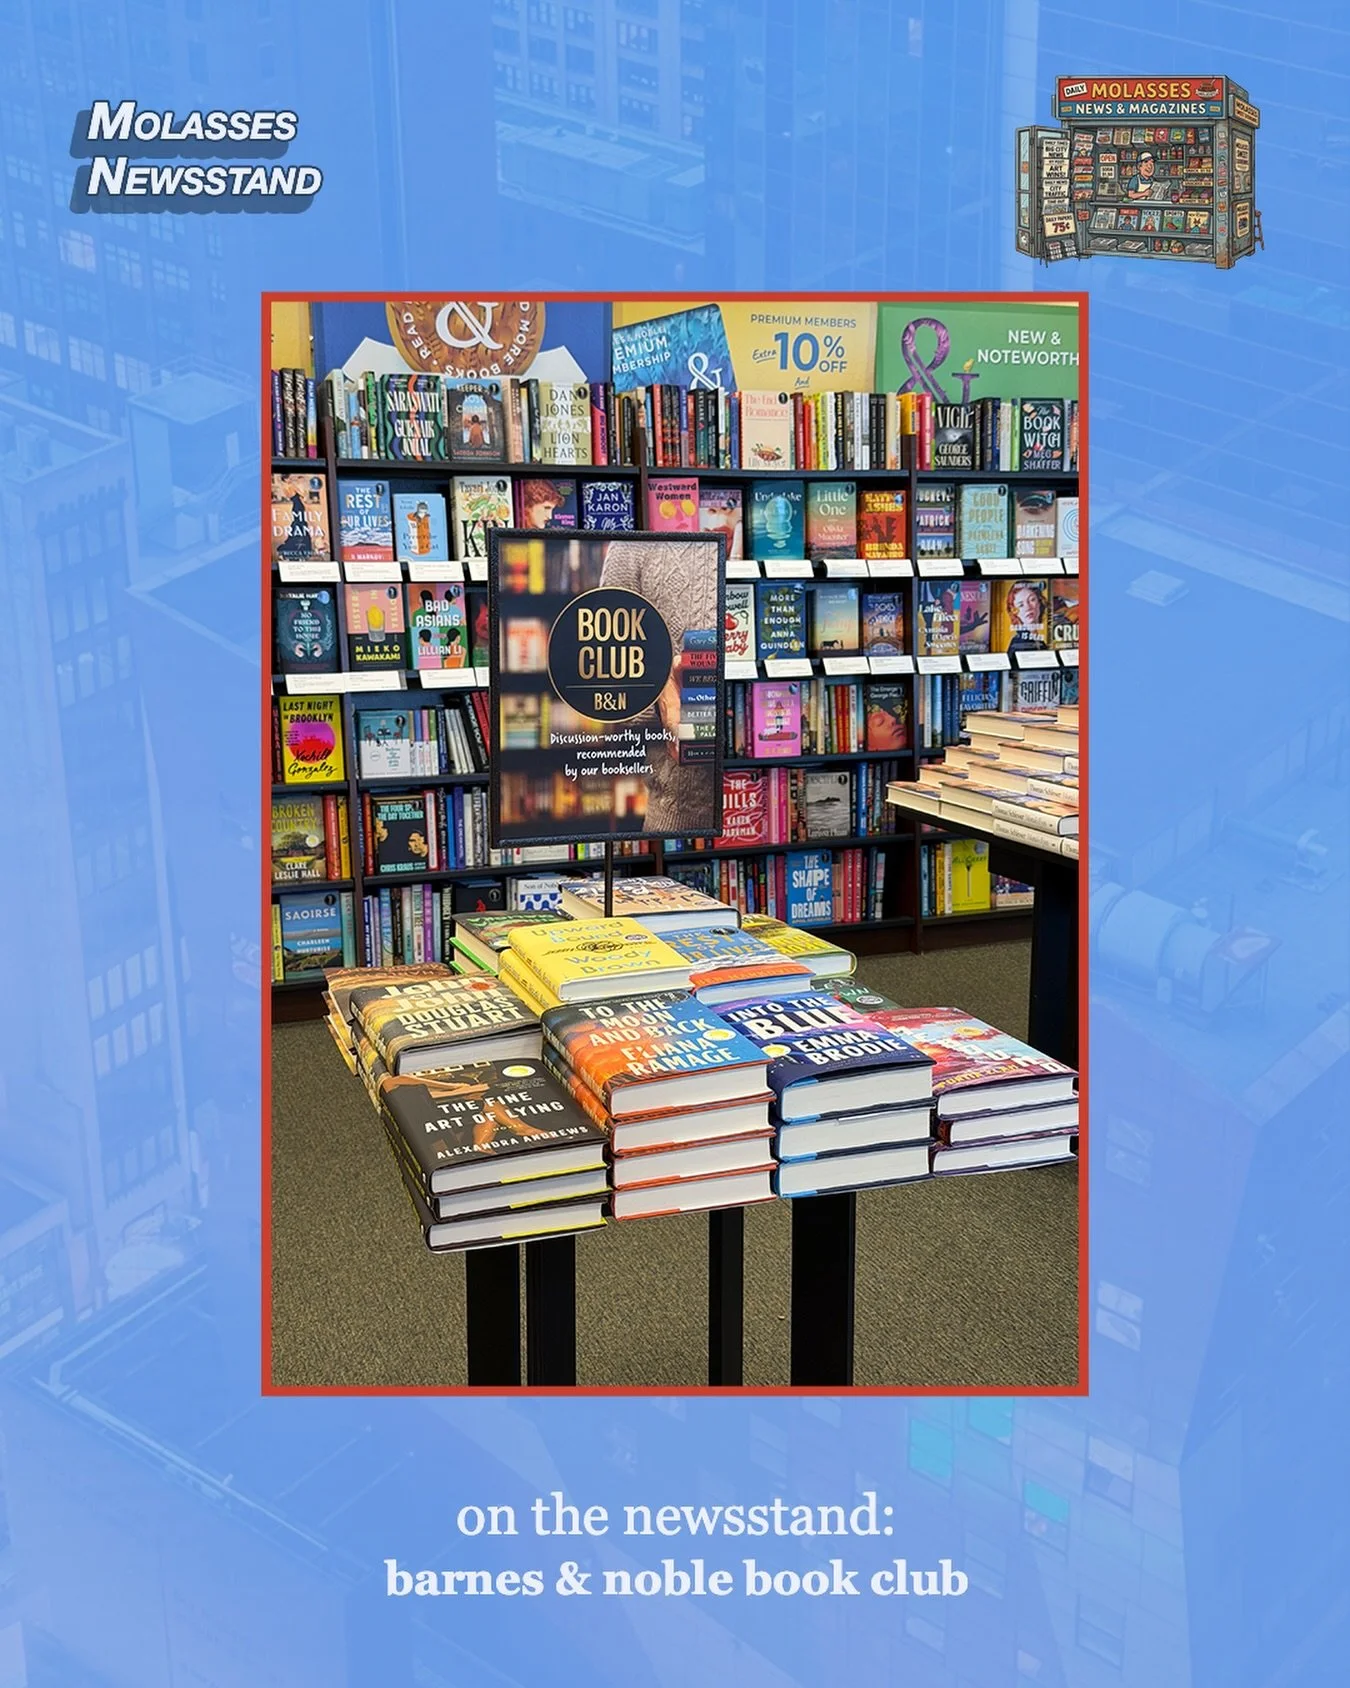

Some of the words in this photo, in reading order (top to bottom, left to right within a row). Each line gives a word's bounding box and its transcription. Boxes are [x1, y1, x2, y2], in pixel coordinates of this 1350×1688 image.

[751, 314, 801, 325] PREMIUM
[804, 317, 856, 328] MEMBERS
[403, 312, 431, 359] READ
[503, 319, 530, 365] MORE
[1008, 330, 1045, 344] NEW
[1050, 332, 1061, 345] &
[752, 349, 777, 360] Extra
[819, 360, 848, 373] OFF
[549, 390, 578, 401] DAN
[545, 403, 585, 416] JONES
[745, 407, 788, 417] Romance
[937, 405, 974, 428] VIGIL
[1023, 417, 1061, 430] BOOK
[550, 432, 579, 444] LION
[1023, 433, 1061, 447] WITCH
[543, 447, 588, 458] HEARTS
[938, 444, 968, 455] GEORGE
[1033, 450, 1052, 459] MEG
[935, 456, 972, 466] SAUNDERS
[1023, 461, 1061, 470] SHAFFER
[650, 481, 697, 492] Westward
[346, 494, 381, 509] REST
[655, 491, 691, 501] Women
[816, 488, 849, 503] Little
[588, 503, 628, 512] KARON
[819, 503, 847, 516] One
[272, 509, 322, 522] FAMILY
[968, 509, 1004, 523] PEOPLE
[273, 525, 324, 537] DRAMA
[425, 600, 450, 613] BAD
[771, 605, 795, 613] THAN
[416, 615, 460, 627] ASIANS
[578, 608, 647, 641] BOOK
[770, 630, 796, 638] ANNA
[418, 646, 451, 656] LILLIAN
[452, 645, 463, 655] LI
[578, 646, 645, 680] CLUB
[1020, 680, 1059, 703] GRIFFIN
[283, 701, 304, 711] LAST
[307, 701, 333, 710] NIGHT
[594, 692, 627, 711] B&N
[290, 713, 334, 723] BROOKLYN
[550, 729, 641, 746] Discussion-worthy
[576, 746, 647, 760] recommended
[288, 762, 337, 779] Gonzalez
[565, 764, 578, 782] by
[581, 767, 599, 776] our
[730, 779, 747, 790] THE
[272, 804, 314, 819] BROKEN
[804, 854, 819, 869] THE
[274, 871, 299, 880] LESLIE
[301, 869, 320, 878] HALL
[792, 870, 830, 888] SHAPE
[806, 888, 816, 901] OF
[285, 907, 336, 920] SAOIRSE
[791, 901, 831, 918] DREAMS
[532, 922, 624, 936] Upward
[551, 931, 623, 944] Bound
[564, 950, 651, 964] Woody
[580, 960, 661, 974] Brown
[381, 976, 488, 999] John
[392, 989, 506, 1013] John
[396, 996, 516, 1027] DOUGLAS
[579, 1005, 615, 1020] TO
[621, 998, 673, 1015] THE
[727, 1003, 784, 1022] INTO
[792, 996, 835, 1009] THE
[403, 1006, 527, 1040] STUART
[602, 1010, 676, 1030] MOON
[742, 1006, 866, 1041] BLUE
[589, 1028, 641, 1047] AND
[643, 1017, 716, 1039] BACK
[792, 1030, 881, 1053] EMMA
[621, 1037, 718, 1062] ELIANA
[805, 1039, 908, 1066] BRODIE
[626, 1046, 741, 1076] RAMAGE
[437, 1099, 483, 1114] THE
[485, 1091, 533, 1106] FINE
[425, 1116, 464, 1133] ART
[472, 1111, 497, 1124] OF
[506, 1101, 565, 1120] LYING
[437, 1137, 520, 1160] ALEXANDRA
[523, 1125, 589, 1144] ANDREWS
